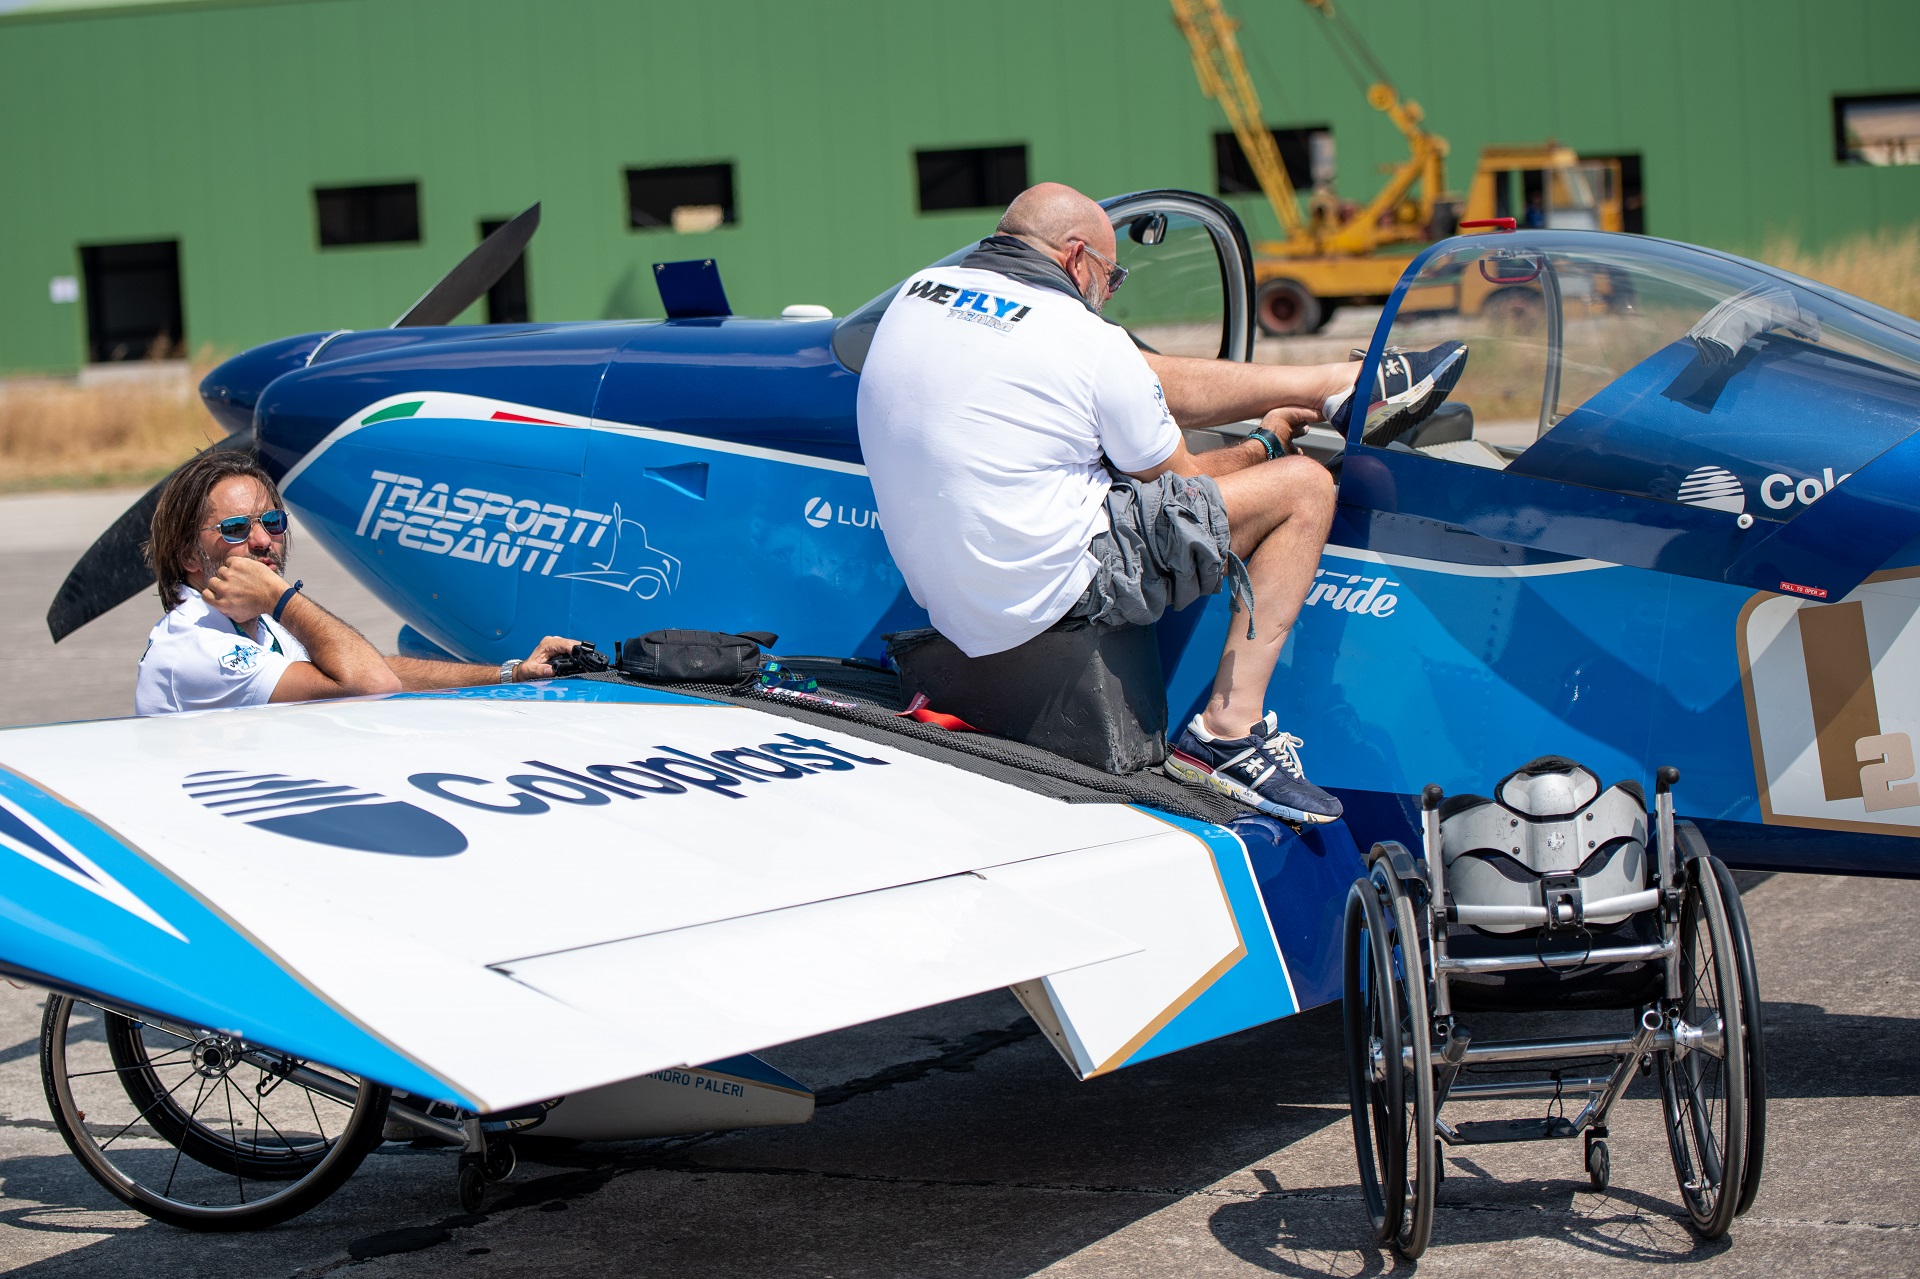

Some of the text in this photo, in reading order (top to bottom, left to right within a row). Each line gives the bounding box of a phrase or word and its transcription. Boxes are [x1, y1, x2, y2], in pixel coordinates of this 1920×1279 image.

[946, 308, 1014, 332] TEAM
[355, 469, 613, 548] TRASPORTI
[1760, 467, 1852, 510] Col
[371, 509, 566, 576] PESANTI
[1304, 569, 1398, 618] ride
[407, 732, 892, 815] Coloplast
[695, 1077, 744, 1097] PALERI
